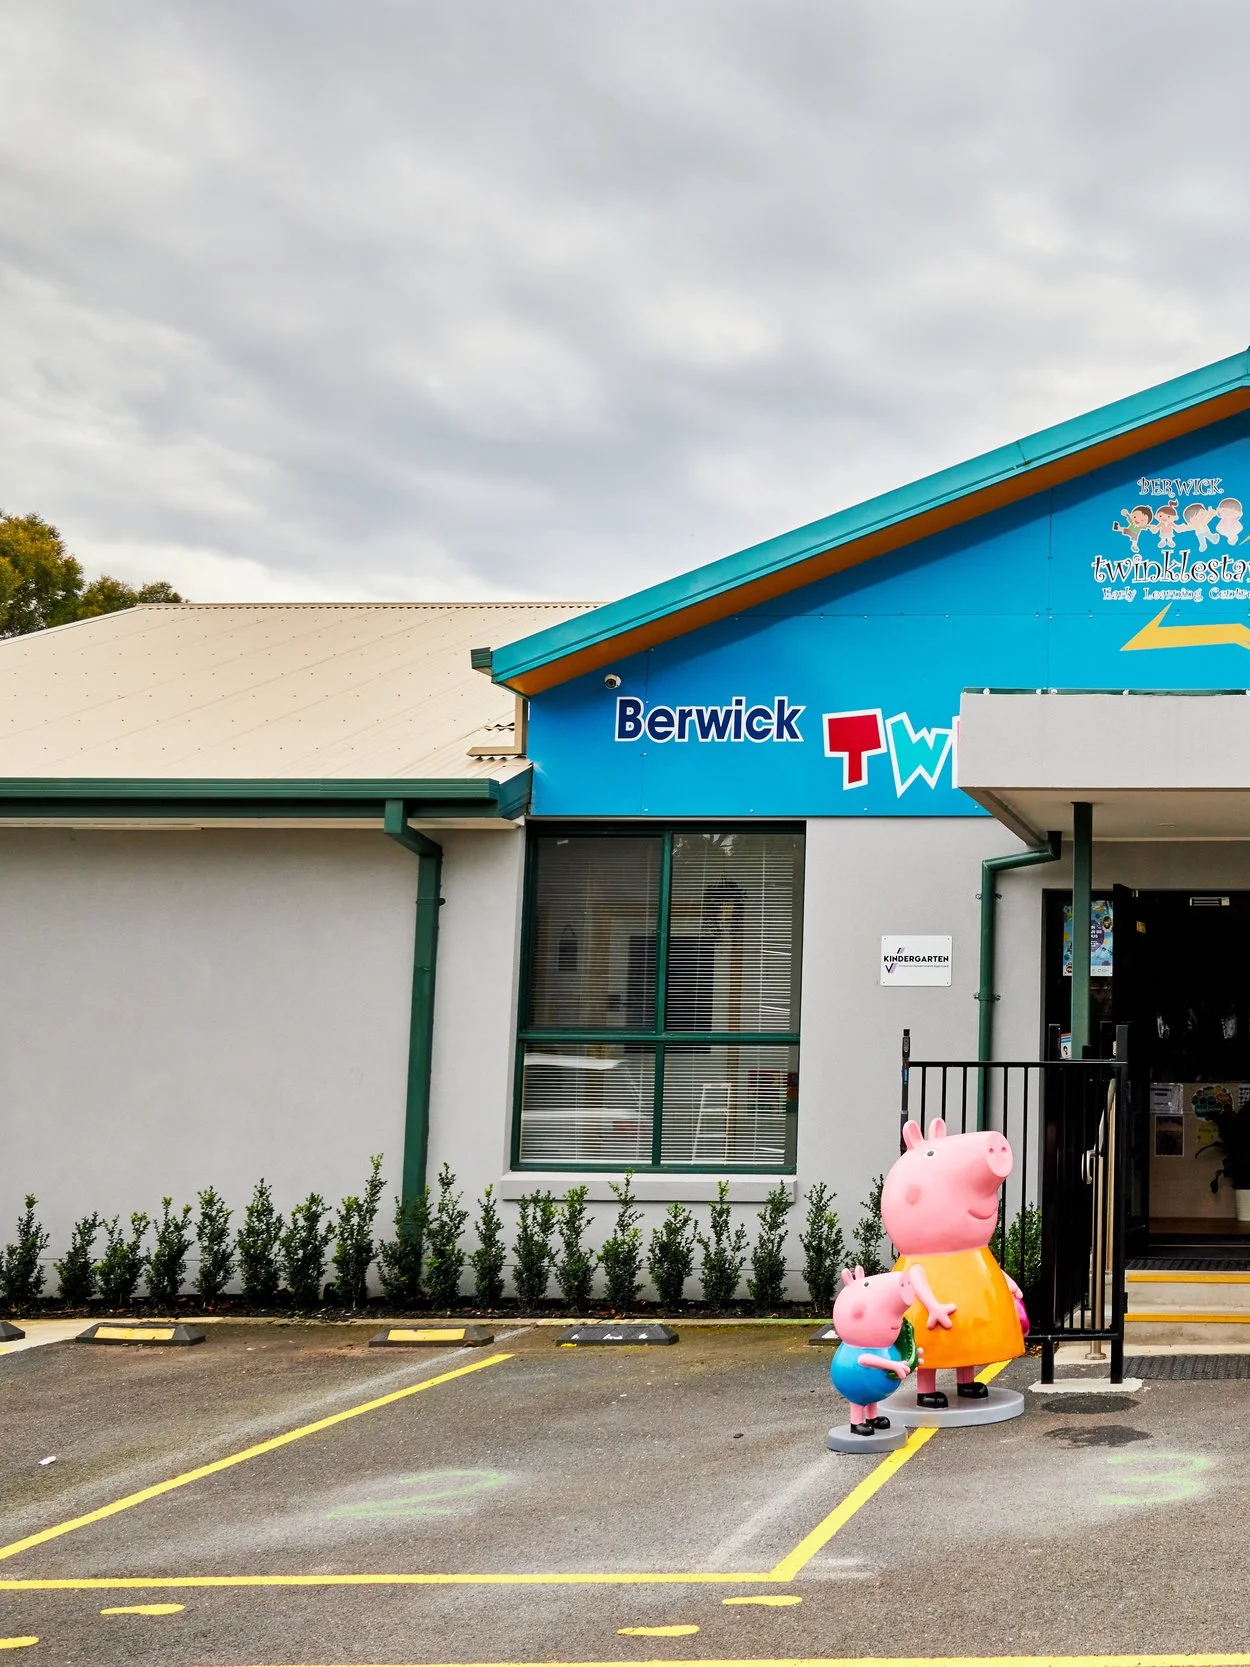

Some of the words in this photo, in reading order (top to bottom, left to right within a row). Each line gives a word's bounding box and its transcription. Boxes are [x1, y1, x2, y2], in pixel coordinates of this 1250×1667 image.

[1137, 477, 1224, 496] BERWICK
[1102, 587, 1136, 602] Early
[1143, 587, 1202, 602] Learning
[615, 696, 806, 743] Berwick
[822, 708, 960, 799] TW
